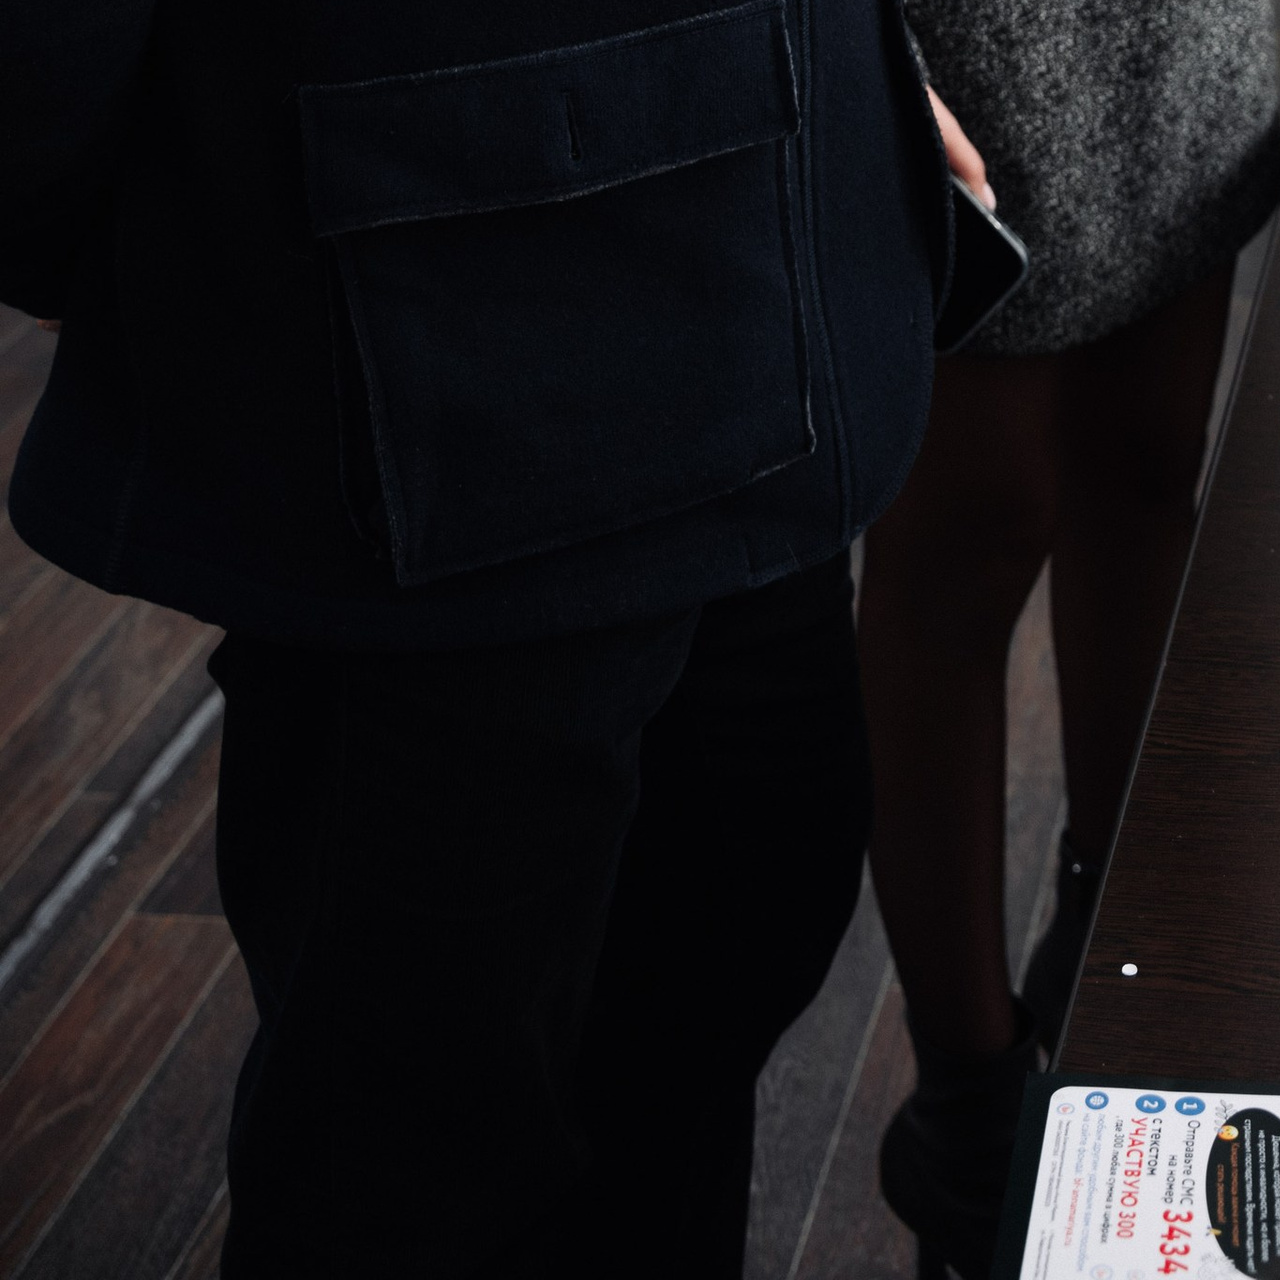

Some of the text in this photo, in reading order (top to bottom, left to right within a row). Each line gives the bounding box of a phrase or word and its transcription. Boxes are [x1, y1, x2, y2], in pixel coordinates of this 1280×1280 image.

[1109, 1151, 1121, 1177] любая
[1113, 1134, 1125, 1149] 300
[1147, 1118, 1162, 1176] с текстом
[1180, 1119, 1201, 1205] Отправьте СМС
[1116, 1117, 1148, 1239] УЧАСТВУЮ 300
[1163, 1154, 1178, 1204] на номер
[1157, 1209, 1194, 1275] 3434
